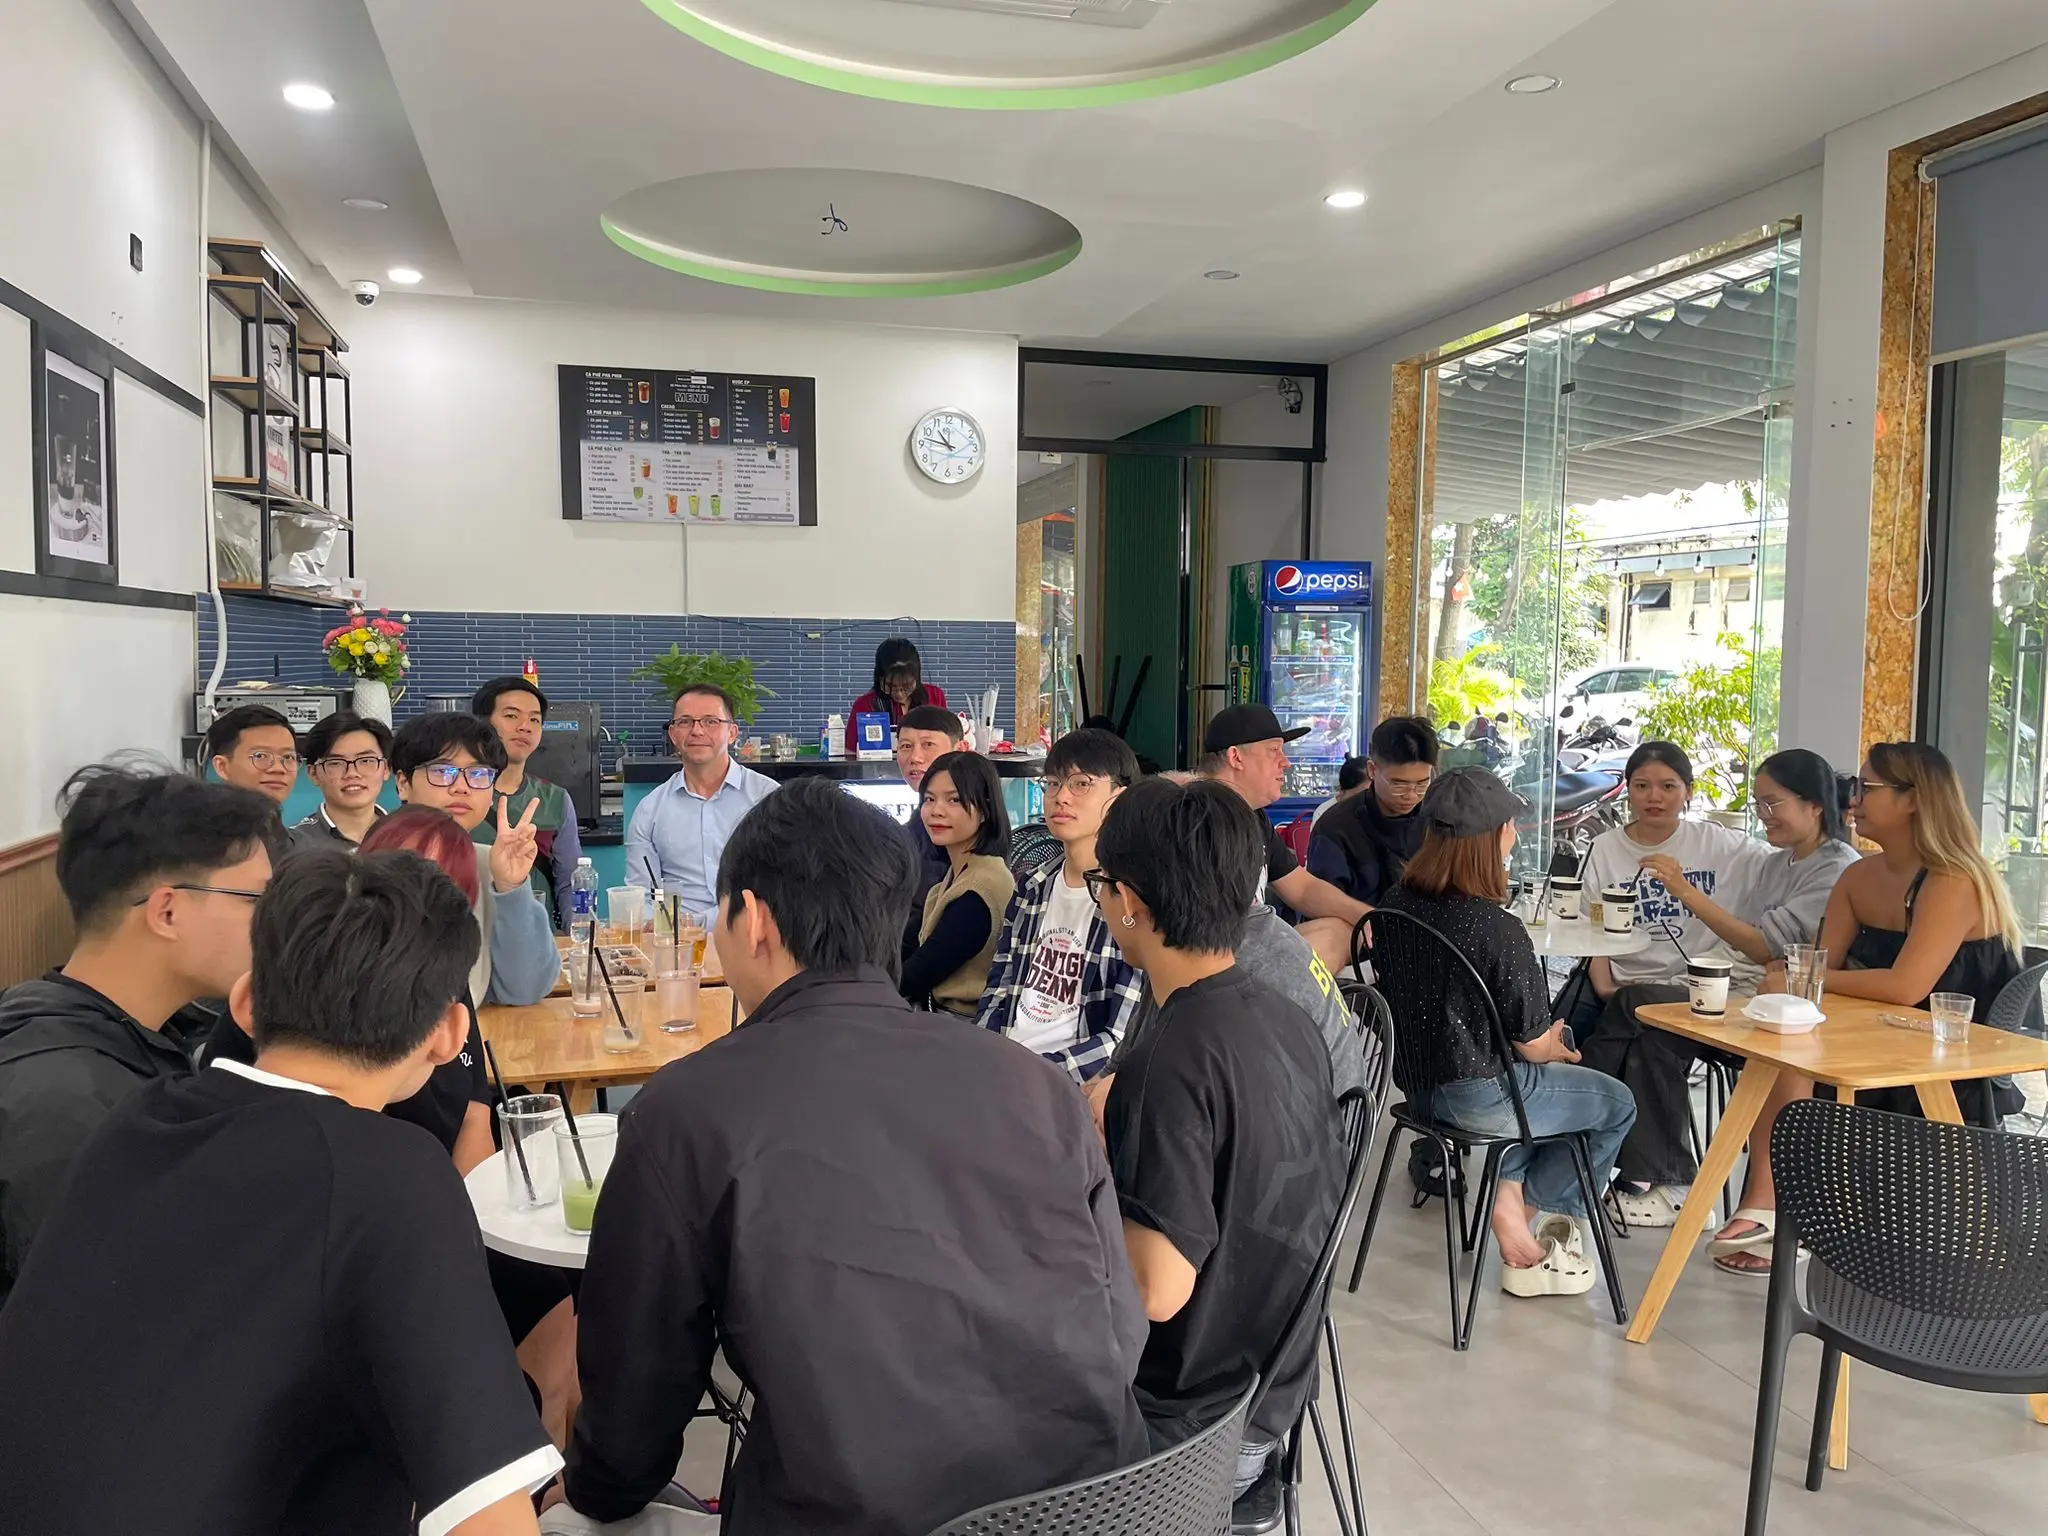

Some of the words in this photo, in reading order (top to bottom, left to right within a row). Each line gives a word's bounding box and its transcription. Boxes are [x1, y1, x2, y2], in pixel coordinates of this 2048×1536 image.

[674, 392, 709, 404] MENU
[934, 418, 941, 428] 11
[945, 415, 953, 424] 12
[960, 420, 964, 428] 1
[923, 427, 932, 437] 10
[968, 429, 974, 439] 2
[918, 440, 924, 449] 9
[972, 443, 978, 453] 3
[922, 454, 928, 463] 8
[967, 457, 973, 466] 4
[931, 462, 938, 472] 7
[957, 466, 964, 475] 5
[945, 468, 951, 477] 6
[1306, 571, 1364, 593] pepsi
